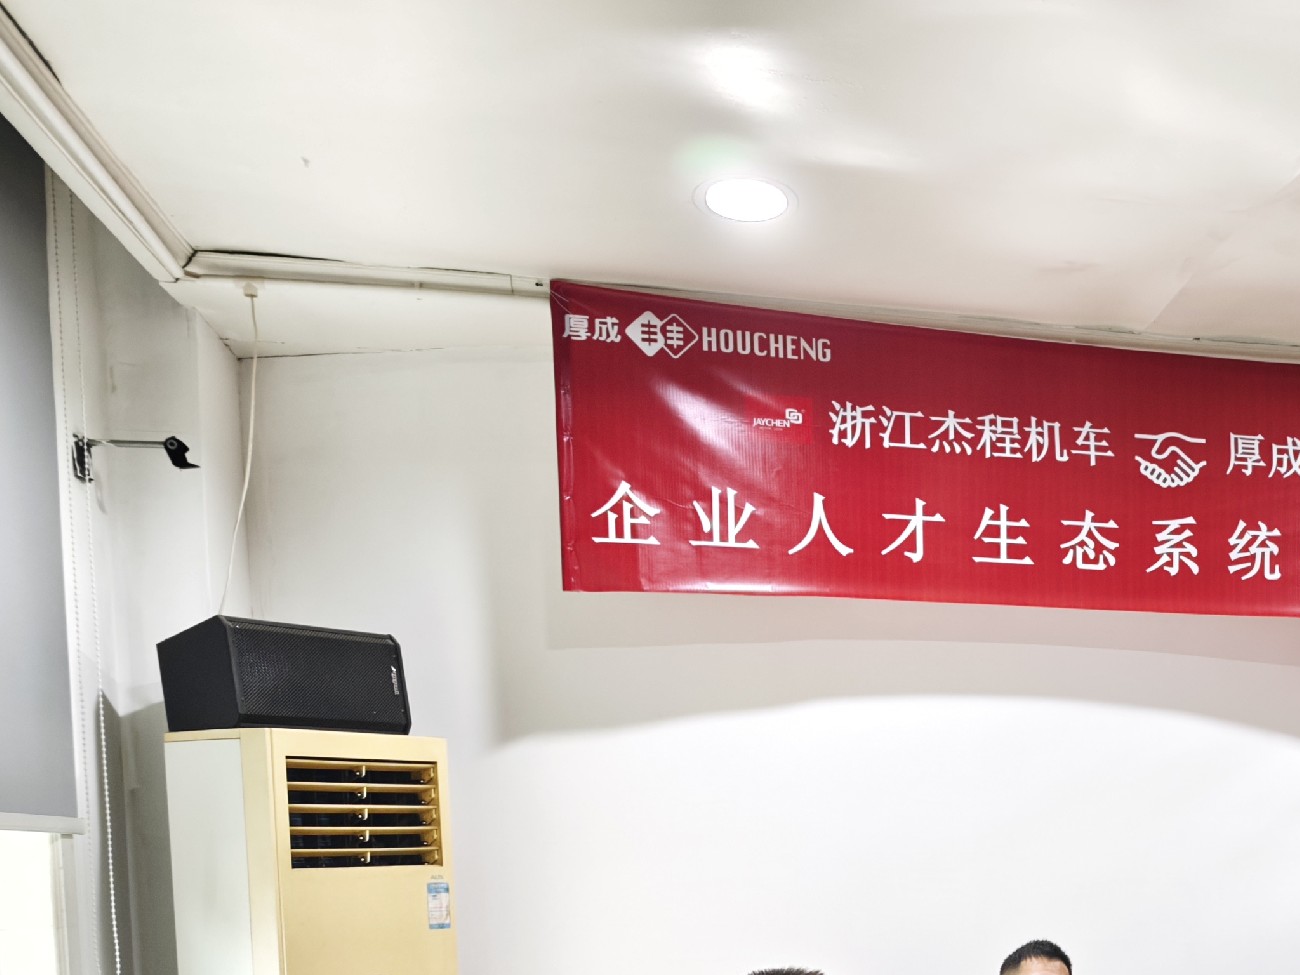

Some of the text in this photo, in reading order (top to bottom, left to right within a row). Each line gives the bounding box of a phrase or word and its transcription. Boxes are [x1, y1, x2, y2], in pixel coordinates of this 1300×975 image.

[563, 313, 622, 343] 厚成
[702, 327, 832, 362] HOUCHENG
[828, 400, 1115, 466] 浙江杰程机车
